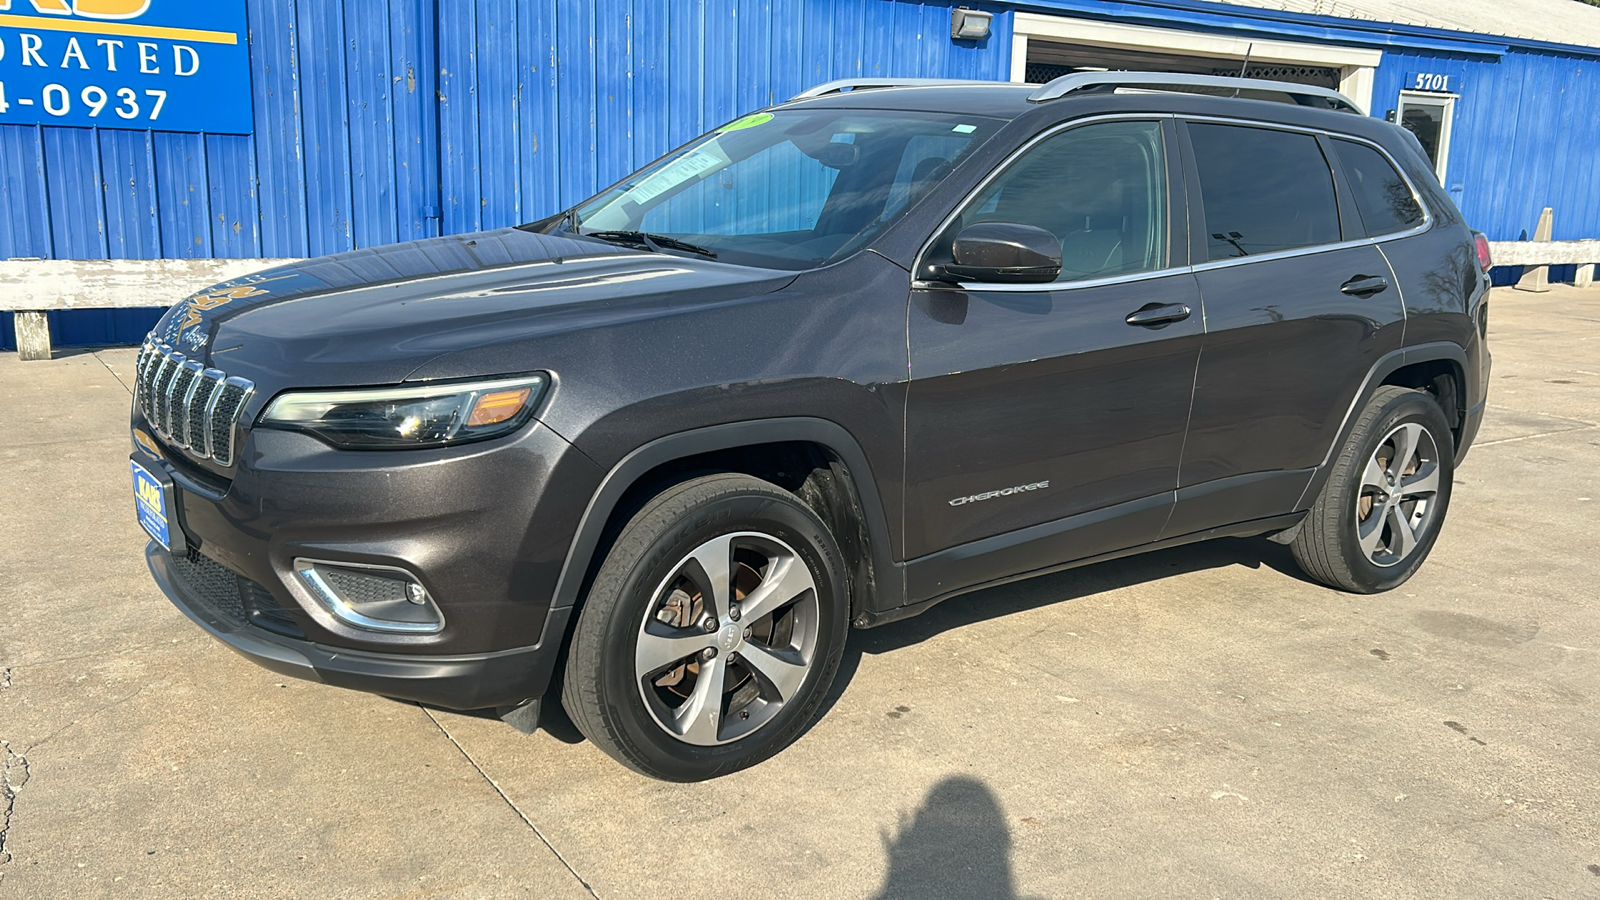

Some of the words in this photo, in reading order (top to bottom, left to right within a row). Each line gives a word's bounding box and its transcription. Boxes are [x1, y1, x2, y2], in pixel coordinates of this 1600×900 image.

[0, 33, 200, 77] RATED
[1415, 73, 1448, 91] 5701
[948, 480, 1049, 507] CHEROKEE
